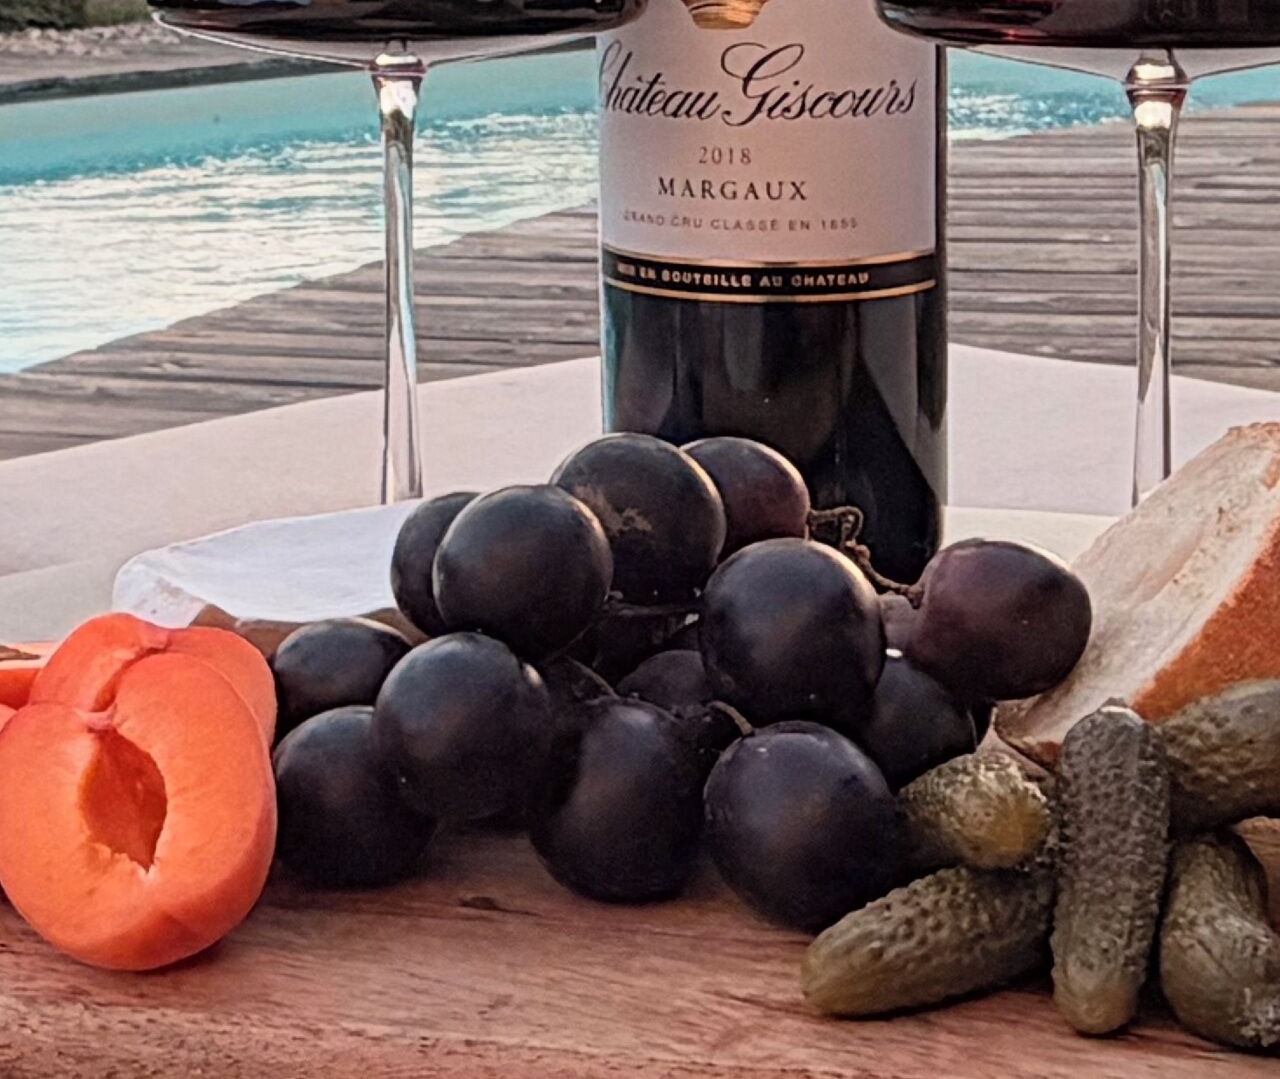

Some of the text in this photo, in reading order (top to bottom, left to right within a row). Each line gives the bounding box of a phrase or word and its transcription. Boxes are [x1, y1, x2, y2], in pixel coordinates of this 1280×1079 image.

[720, 41, 917, 127] Giscours
[698, 146, 752, 165] 2018
[658, 176, 808, 201] MARGAUX
[670, 214, 703, 229] CRU
[788, 219, 811, 232] EN
